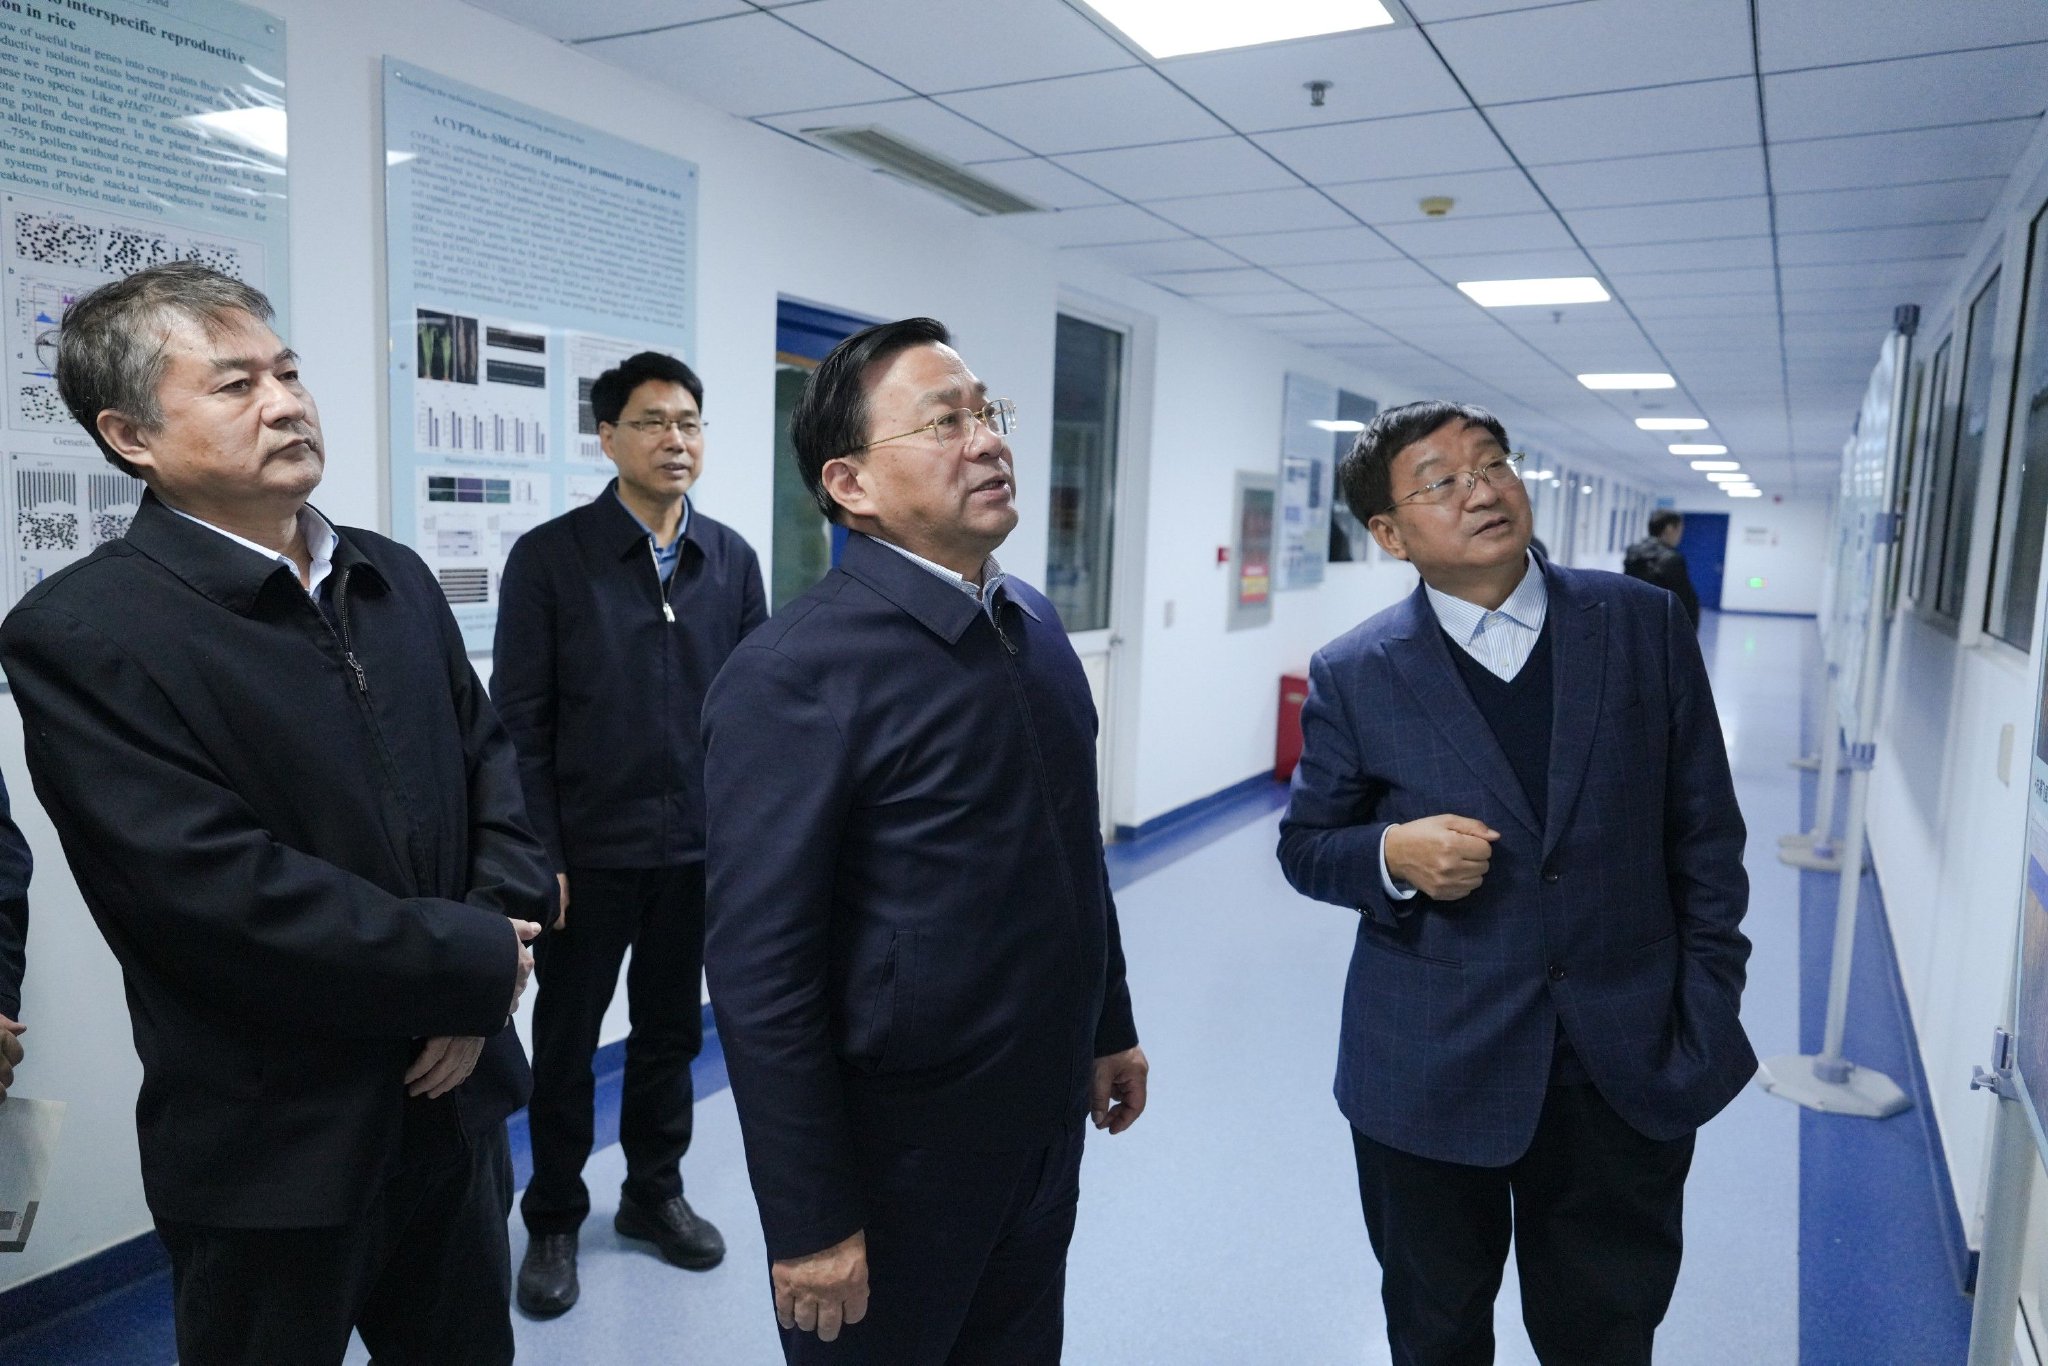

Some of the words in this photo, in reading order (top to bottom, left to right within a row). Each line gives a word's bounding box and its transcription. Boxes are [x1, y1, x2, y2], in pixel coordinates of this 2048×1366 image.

[26, 3, 42, 19] in
[47, 11, 77, 30] rice
[20, 27, 33, 37] of
[34, 31, 67, 48] useful
[70, 41, 91, 55] trait
[94, 49, 123, 64] genes
[125, 56, 145, 70] into
[161, 29, 246, 64] reproductive
[24, 58, 39, 69] we
[44, 64, 76, 80] report
[81, 74, 124, 93] isolation
[127, 87, 138, 97] of
[46, 47, 90, 69] isolation
[94, 64, 122, 78] exists
[125, 70, 166, 91] between
[24, 72, 45, 85] two
[92, 89, 115, 105] Like
[21, 102, 56, 118] pollen
[149, 134, 164, 146] the
[67, 96, 84, 110] but
[89, 104, 122, 121] differs
[127, 112, 137, 124] in
[142, 118, 157, 130] the
[7, 112, 38, 128] allele
[40, 119, 66, 135] from
[68, 128, 119, 148] cultivated
[145, 148, 160, 158] are
[4, 157, 48, 174] systems
[56, 168, 96, 185] provide
[103, 178, 140, 194] stacked
[19, 146, 68, 163] antidotes
[71, 156, 113, 175] function
[115, 167, 126, 178] in
[128, 171, 135, 180] a
[39, 136, 78, 152] pollens
[81, 146, 119, 162] without
[122, 156, 178, 176] co-presence
[181, 169, 192, 179] of
[51, 180, 64, 191] of
[65, 182, 99, 200] hybrid
[102, 193, 126, 205] male
